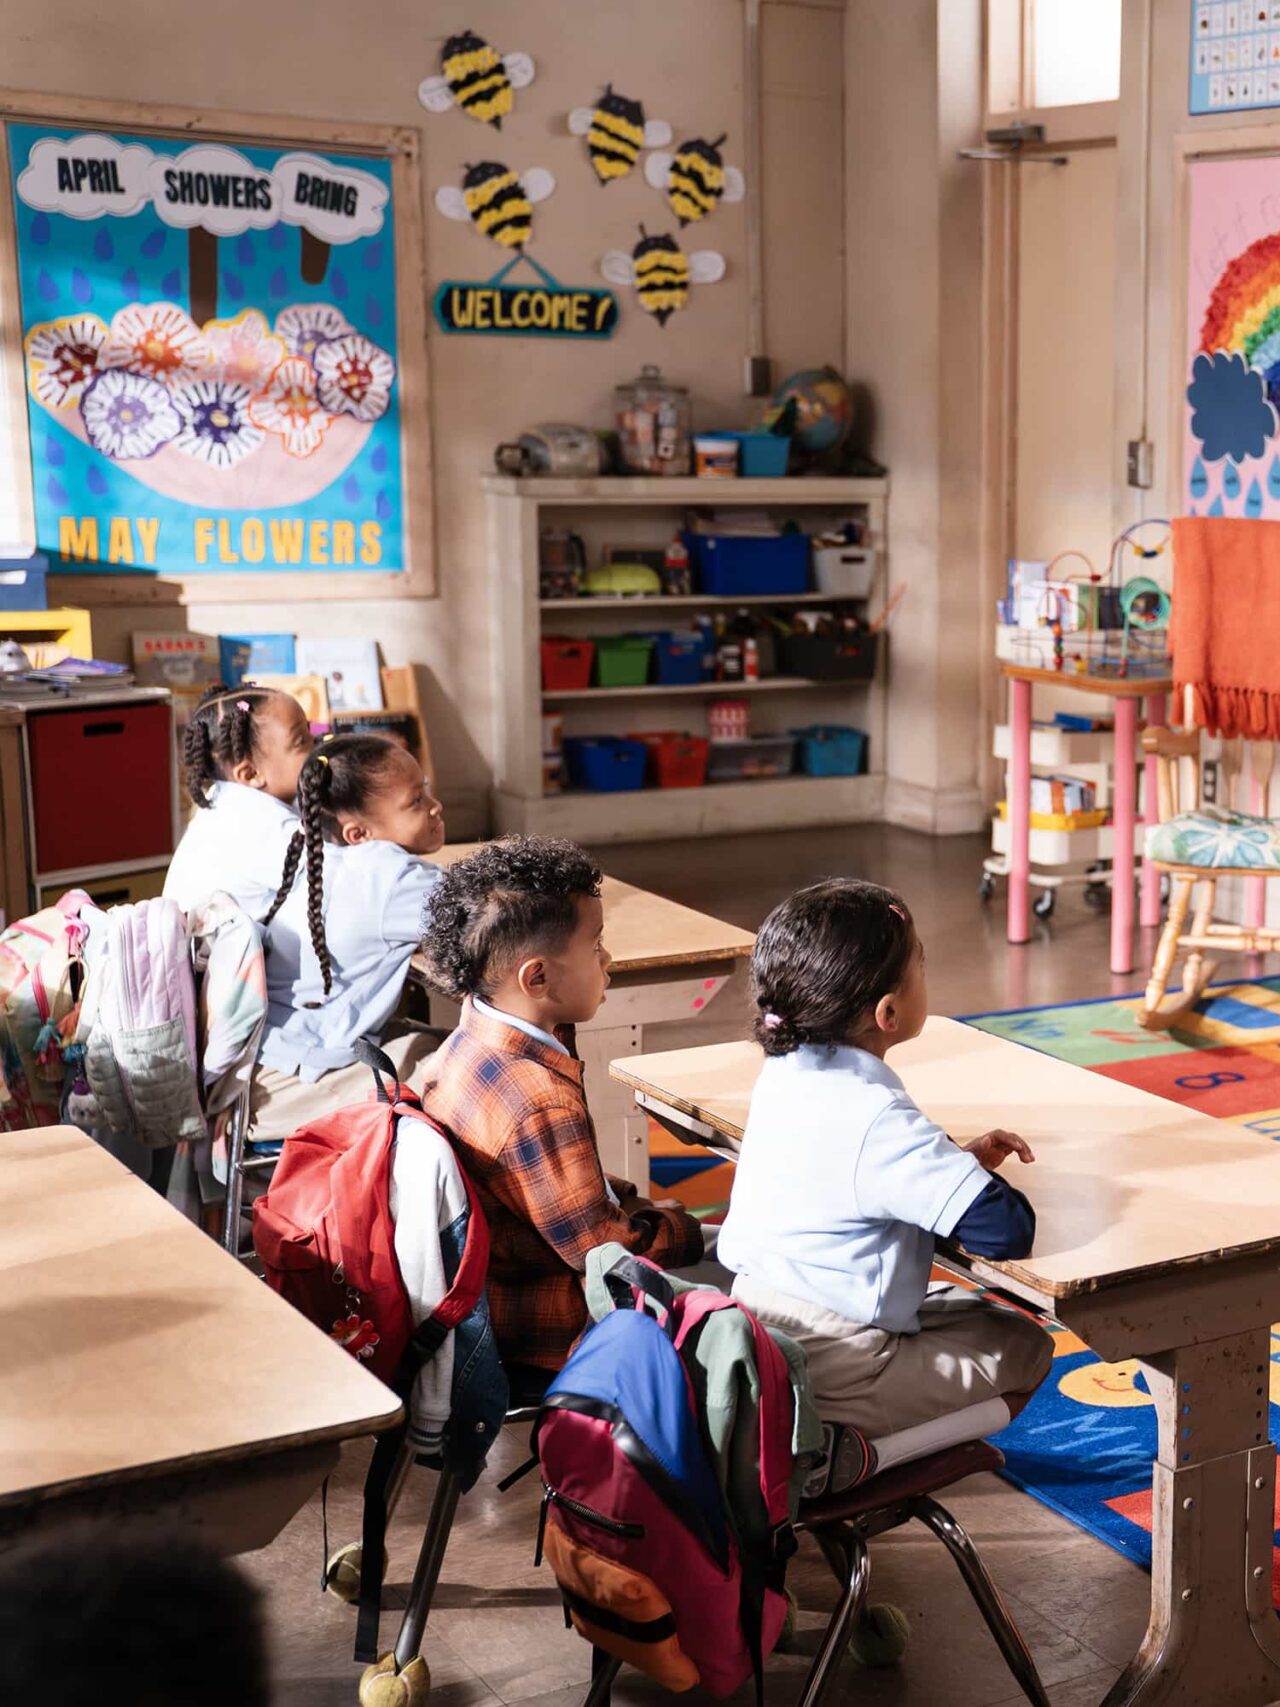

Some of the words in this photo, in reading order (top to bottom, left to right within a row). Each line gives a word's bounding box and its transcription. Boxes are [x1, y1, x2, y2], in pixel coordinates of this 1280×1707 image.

[57, 158, 126, 195] APRIL
[164, 170, 272, 211] SHOWERS
[295, 173, 358, 217] BRING
[452, 287, 612, 331] WELCOME!
[58, 516, 160, 564] MAY
[194, 518, 382, 565] FLOWERS
[1174, 1071, 1246, 1091] 8
